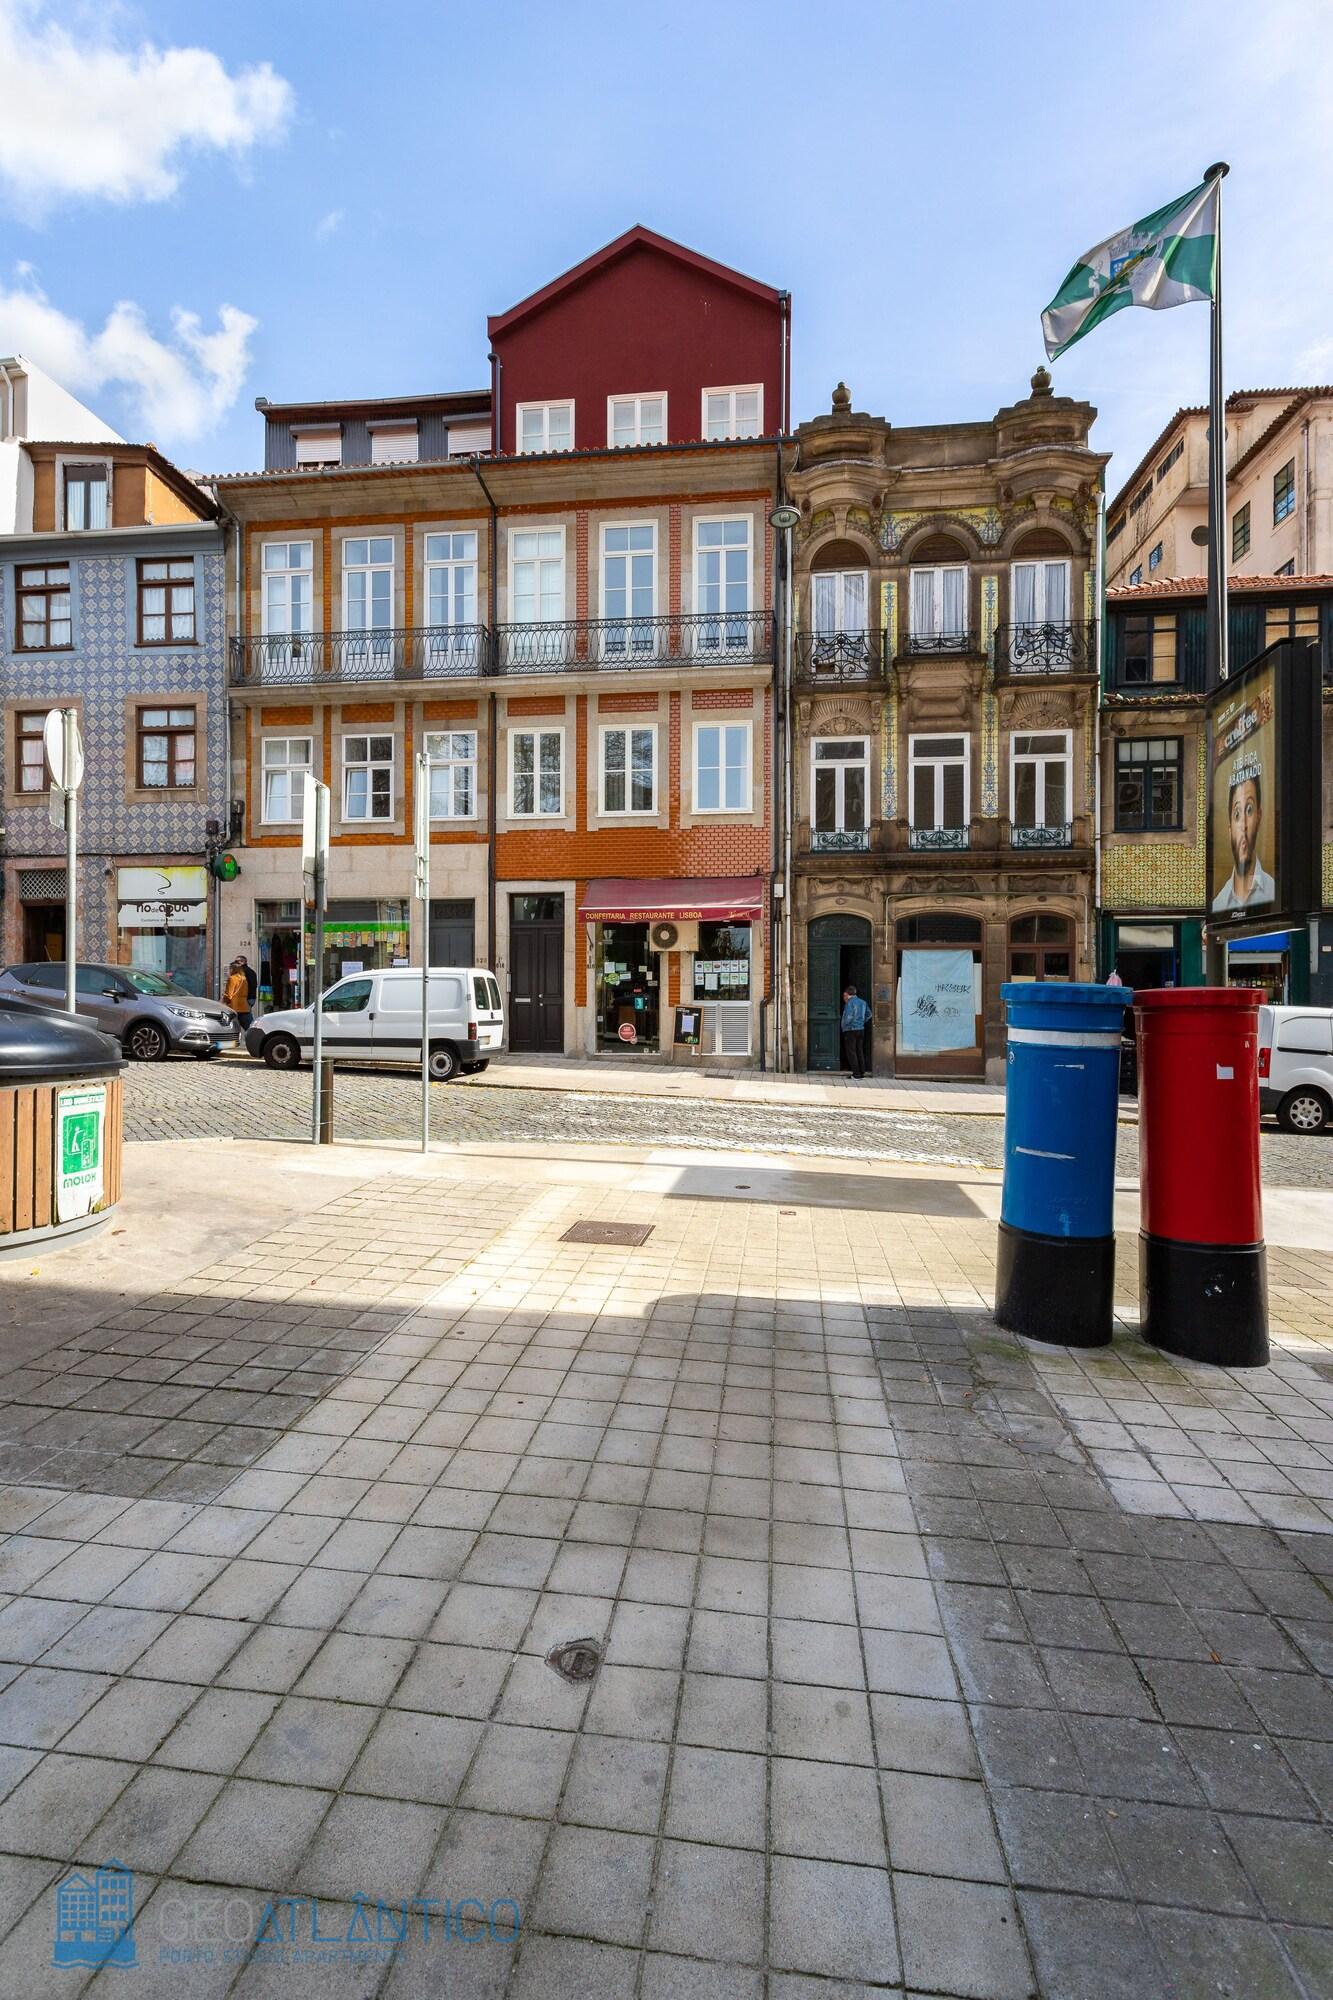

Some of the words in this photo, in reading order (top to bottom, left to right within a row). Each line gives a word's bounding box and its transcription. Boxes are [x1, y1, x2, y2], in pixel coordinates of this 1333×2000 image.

[585, 912, 626, 920] CONFEITARIA
[629, 912, 675, 920] RESTAURANTE
[679, 911, 703, 919] LISBOA
